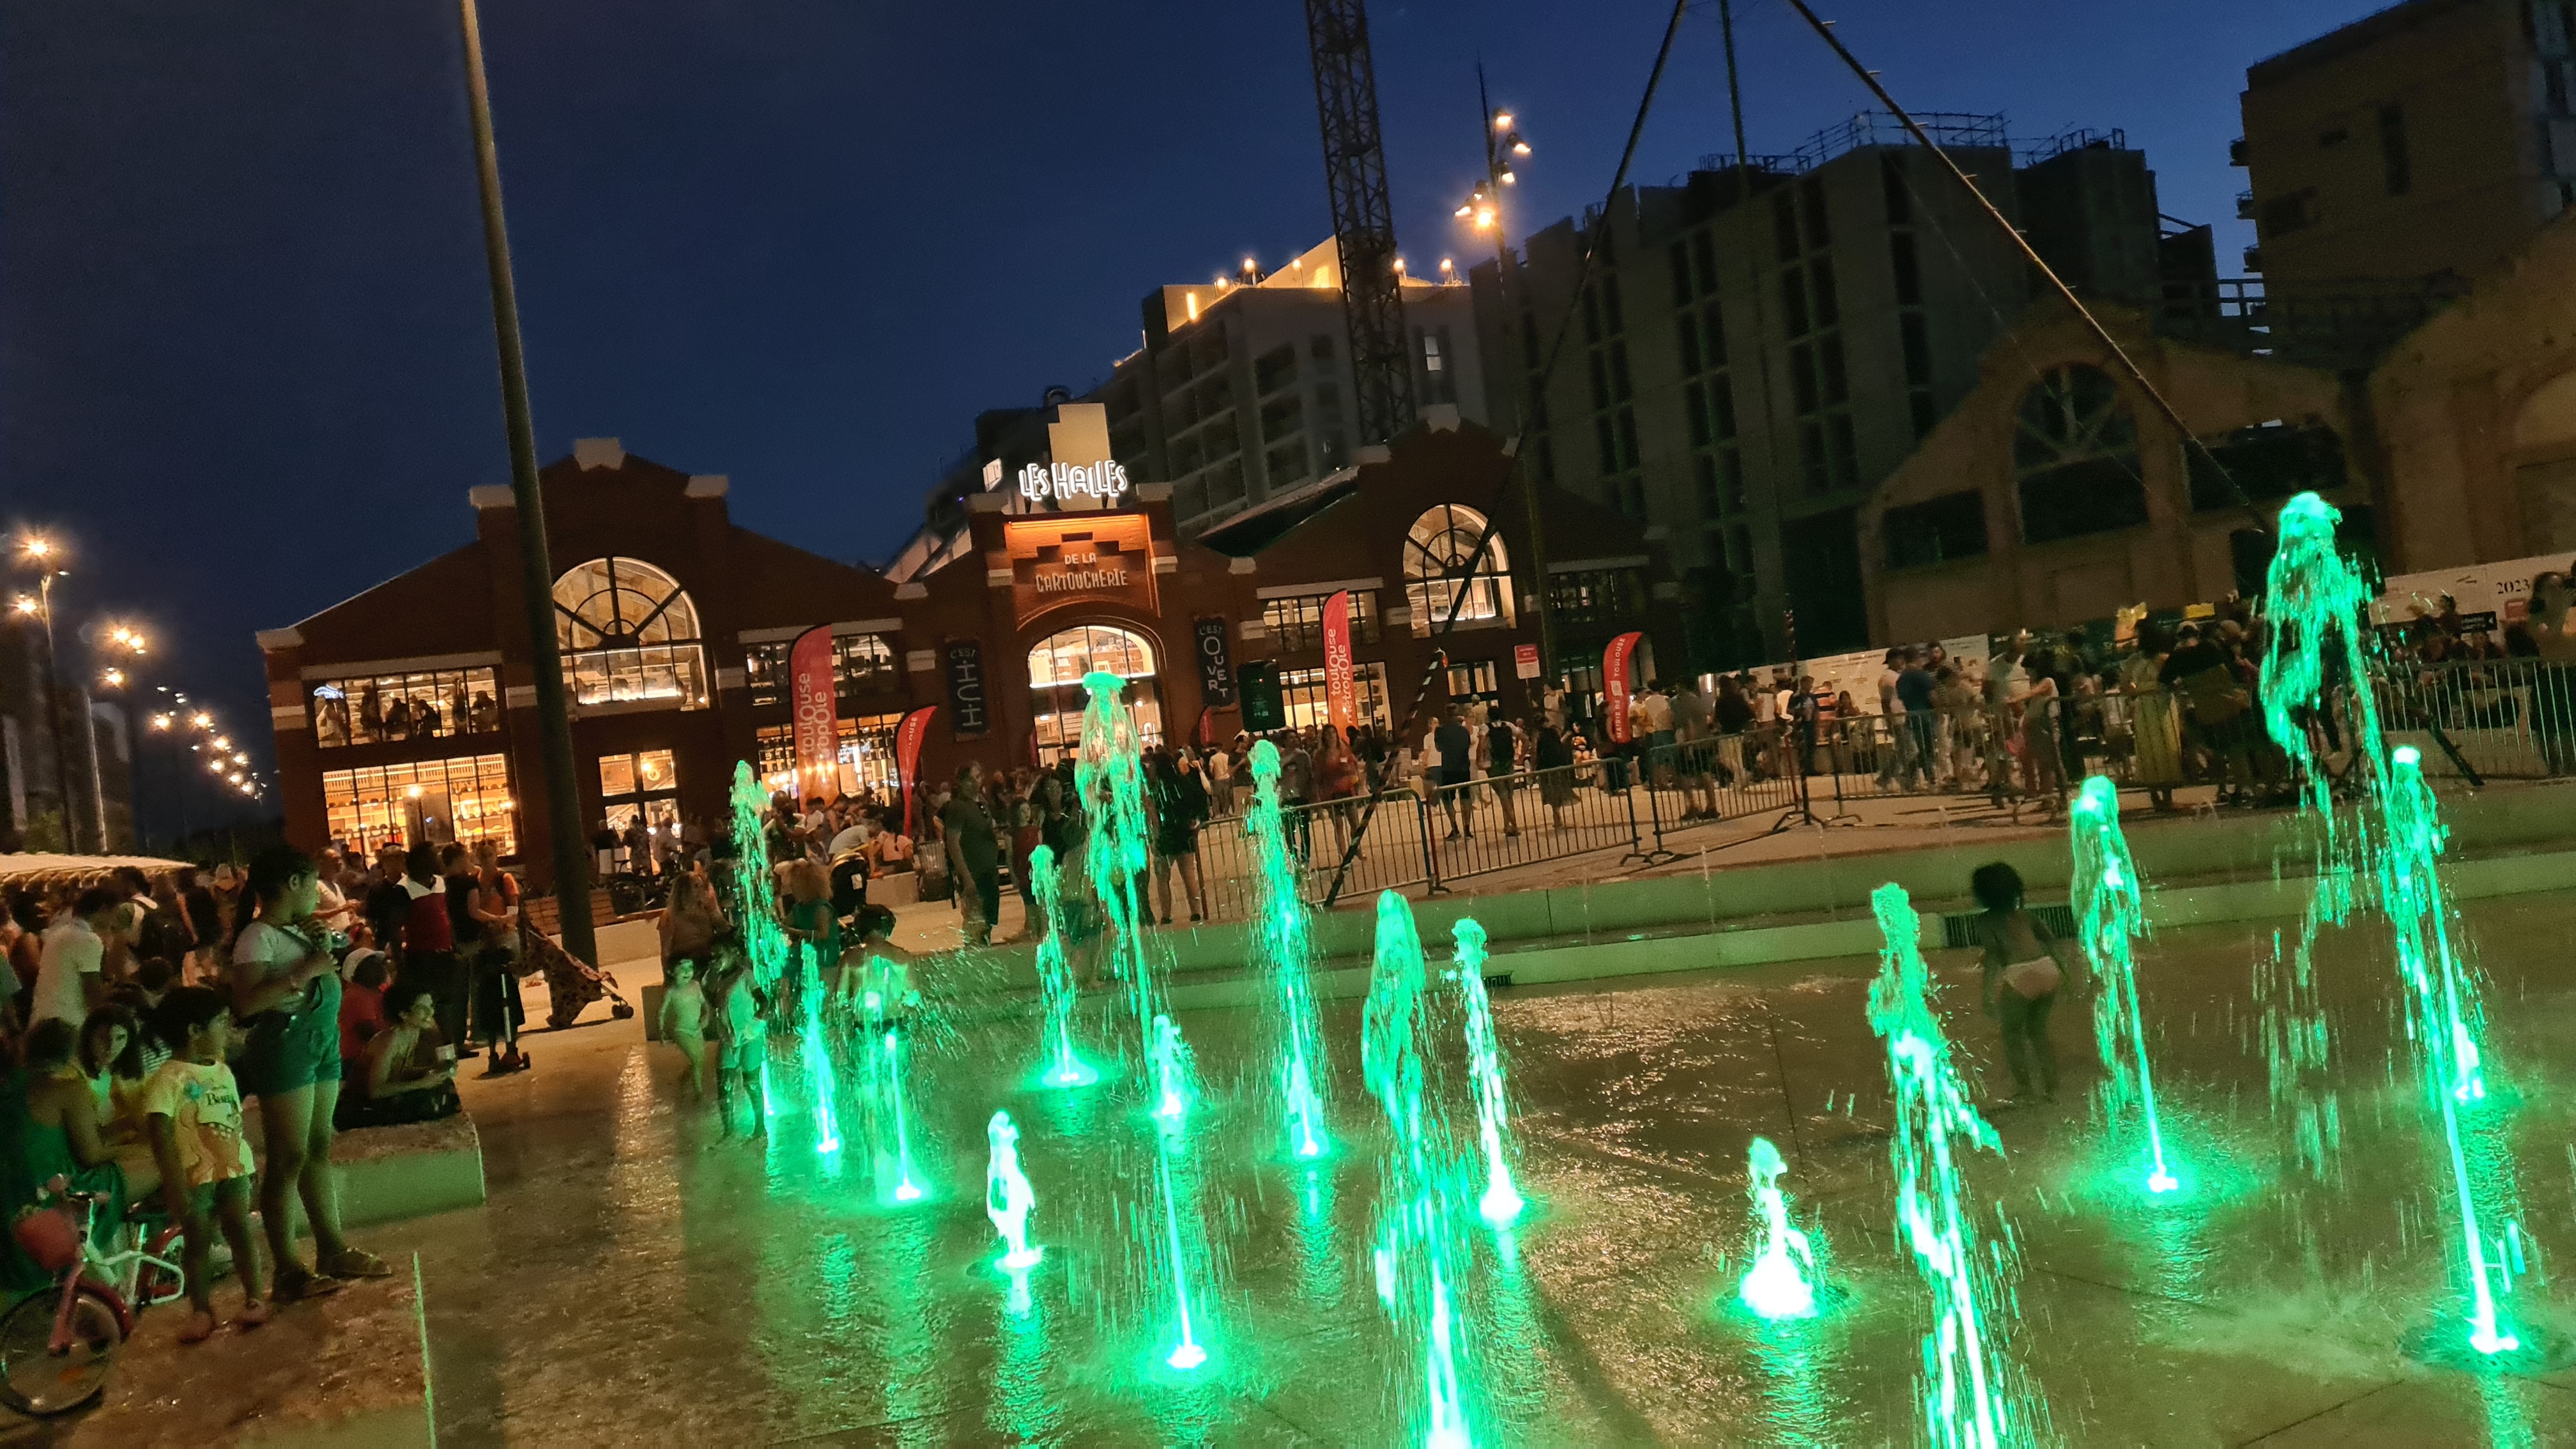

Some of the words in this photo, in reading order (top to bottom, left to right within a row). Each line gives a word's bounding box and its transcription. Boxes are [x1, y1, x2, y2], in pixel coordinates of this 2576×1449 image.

[1018, 463, 1050, 501] LES
[1051, 460, 1128, 500] HALLES
[1064, 554, 1079, 565] DE
[1082, 553, 1096, 564] LA
[1035, 568, 1128, 592] CARTOUCHERIE
[2496, 579, 2530, 594] 2023
[1204, 636, 1228, 698] OUVERT
[1614, 638, 1626, 677] TOULOUSE
[1615, 700, 1620, 709] DE
